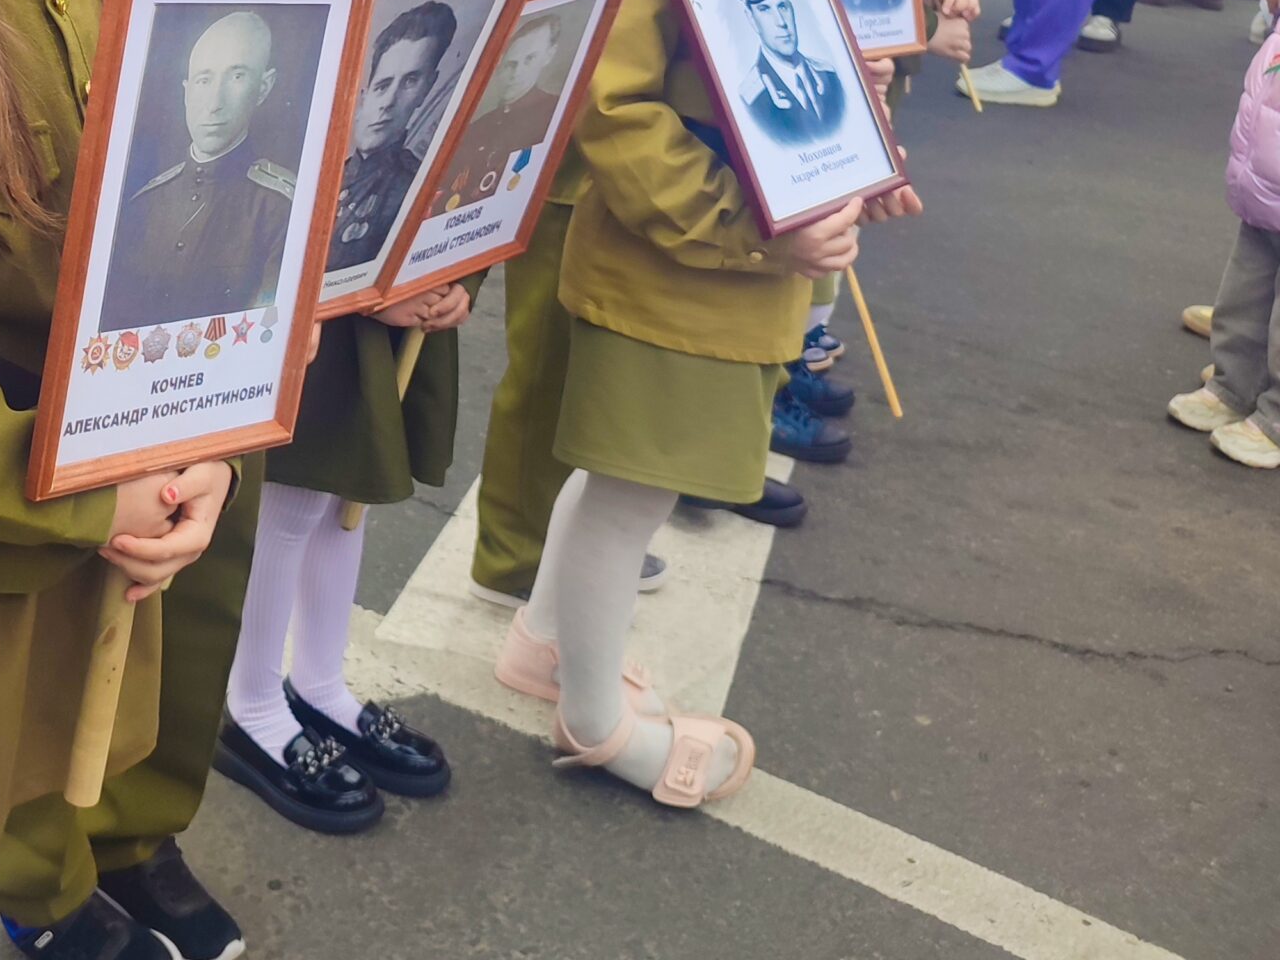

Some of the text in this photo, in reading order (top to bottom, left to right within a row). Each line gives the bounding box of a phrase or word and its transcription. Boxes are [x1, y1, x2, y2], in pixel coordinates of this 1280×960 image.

[790, 165, 821, 186] Андрей
[443, 206, 484, 230] КОВАНОВ
[408, 219, 503, 266] НИКОЛАЙ СТЕПАНОВИЧ
[150, 372, 204, 395] КОЧНЕВ
[63, 382, 274, 438] АЛЕКСАНДР КОНСТАНТИНОВИЧ
